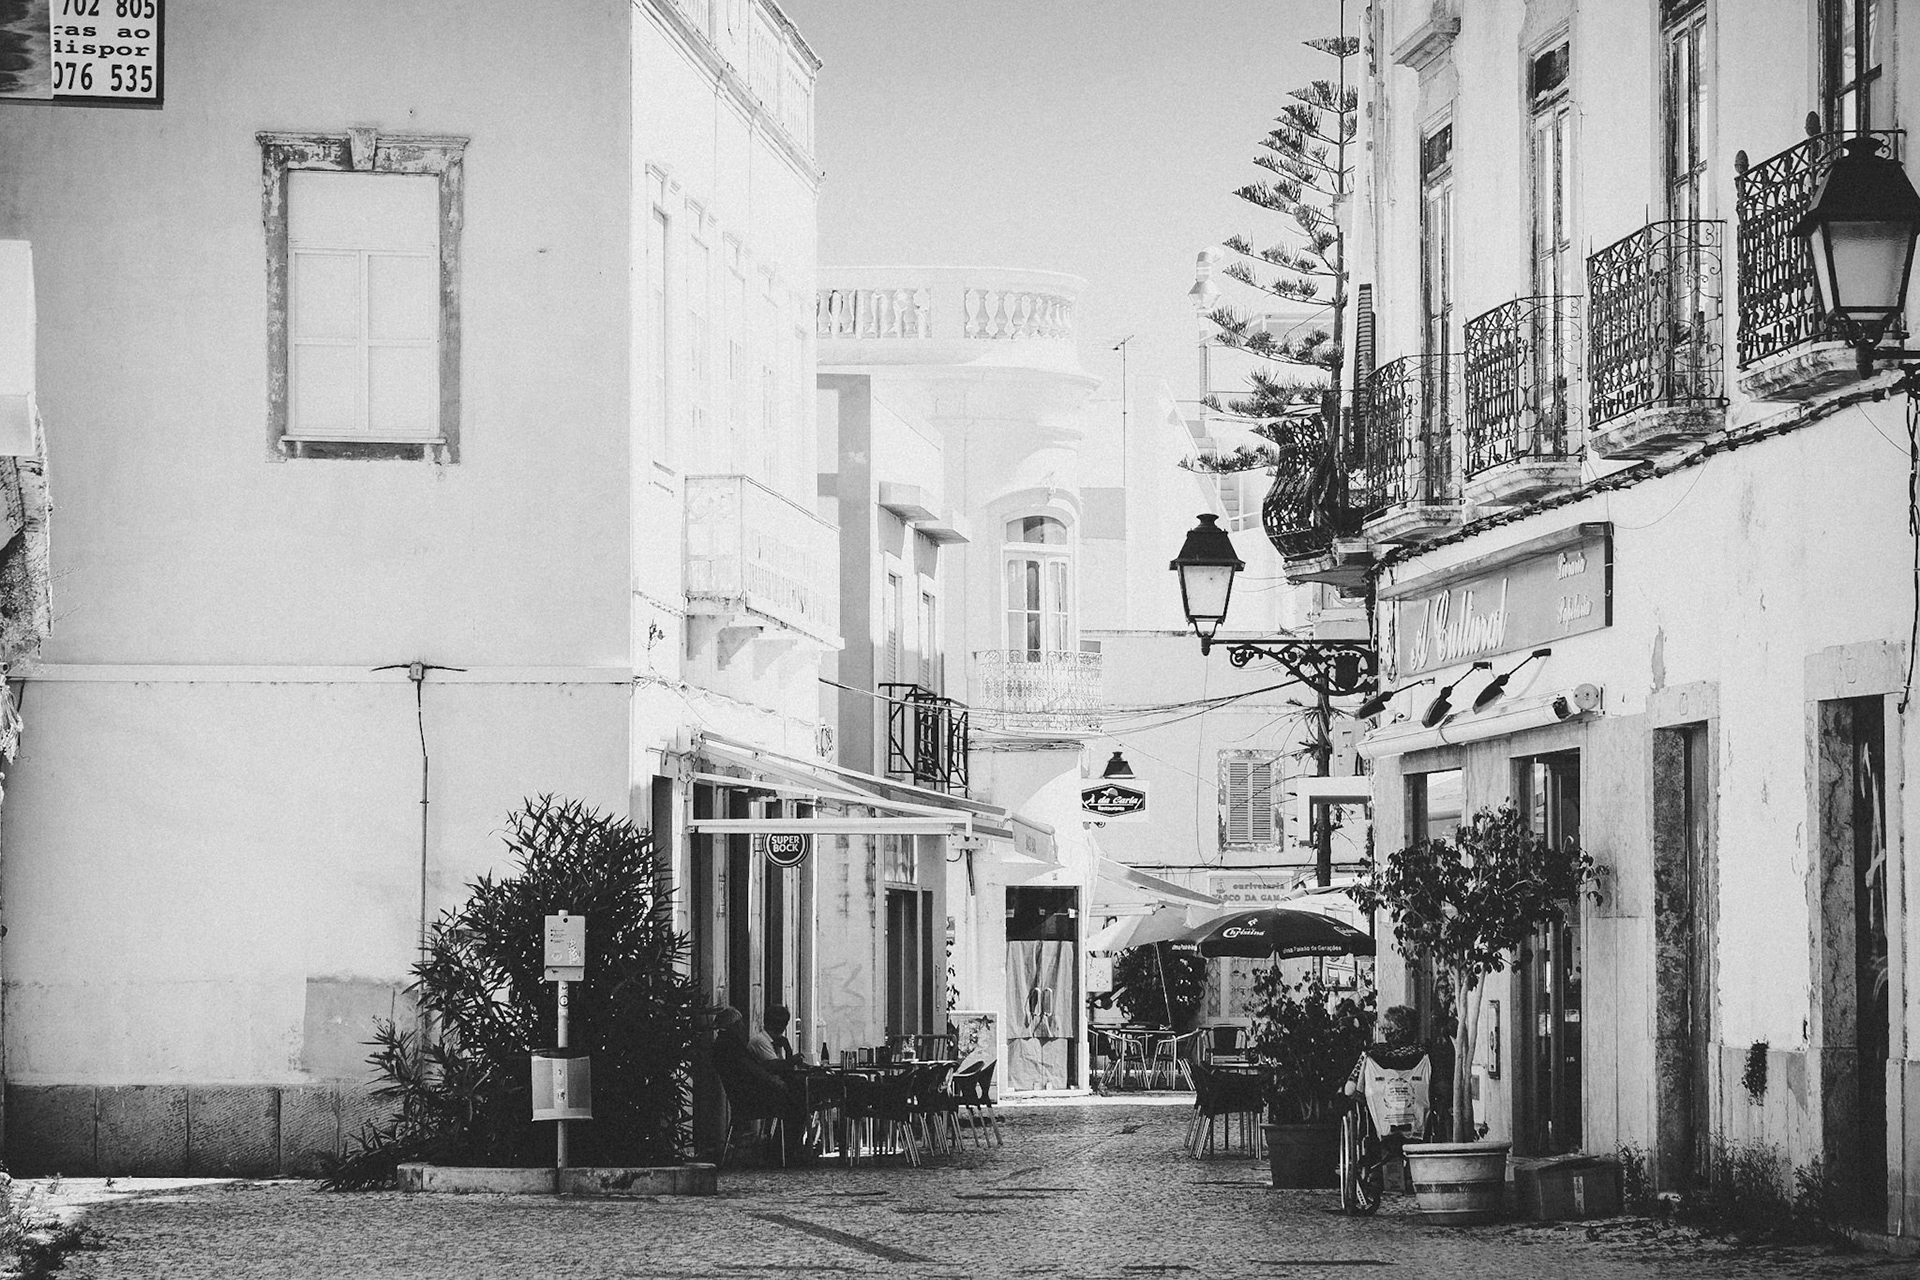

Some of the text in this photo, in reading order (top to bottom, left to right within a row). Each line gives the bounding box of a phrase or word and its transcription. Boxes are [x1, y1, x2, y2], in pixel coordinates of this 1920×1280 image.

[117, 28, 150, 39] ao
[110, 64, 153, 92] 535
[1113, 796, 1138, 804] Carla
[771, 836, 799, 844] SUPER
[773, 843, 798, 852] BOCK
[1244, 894, 1257, 902] DA
